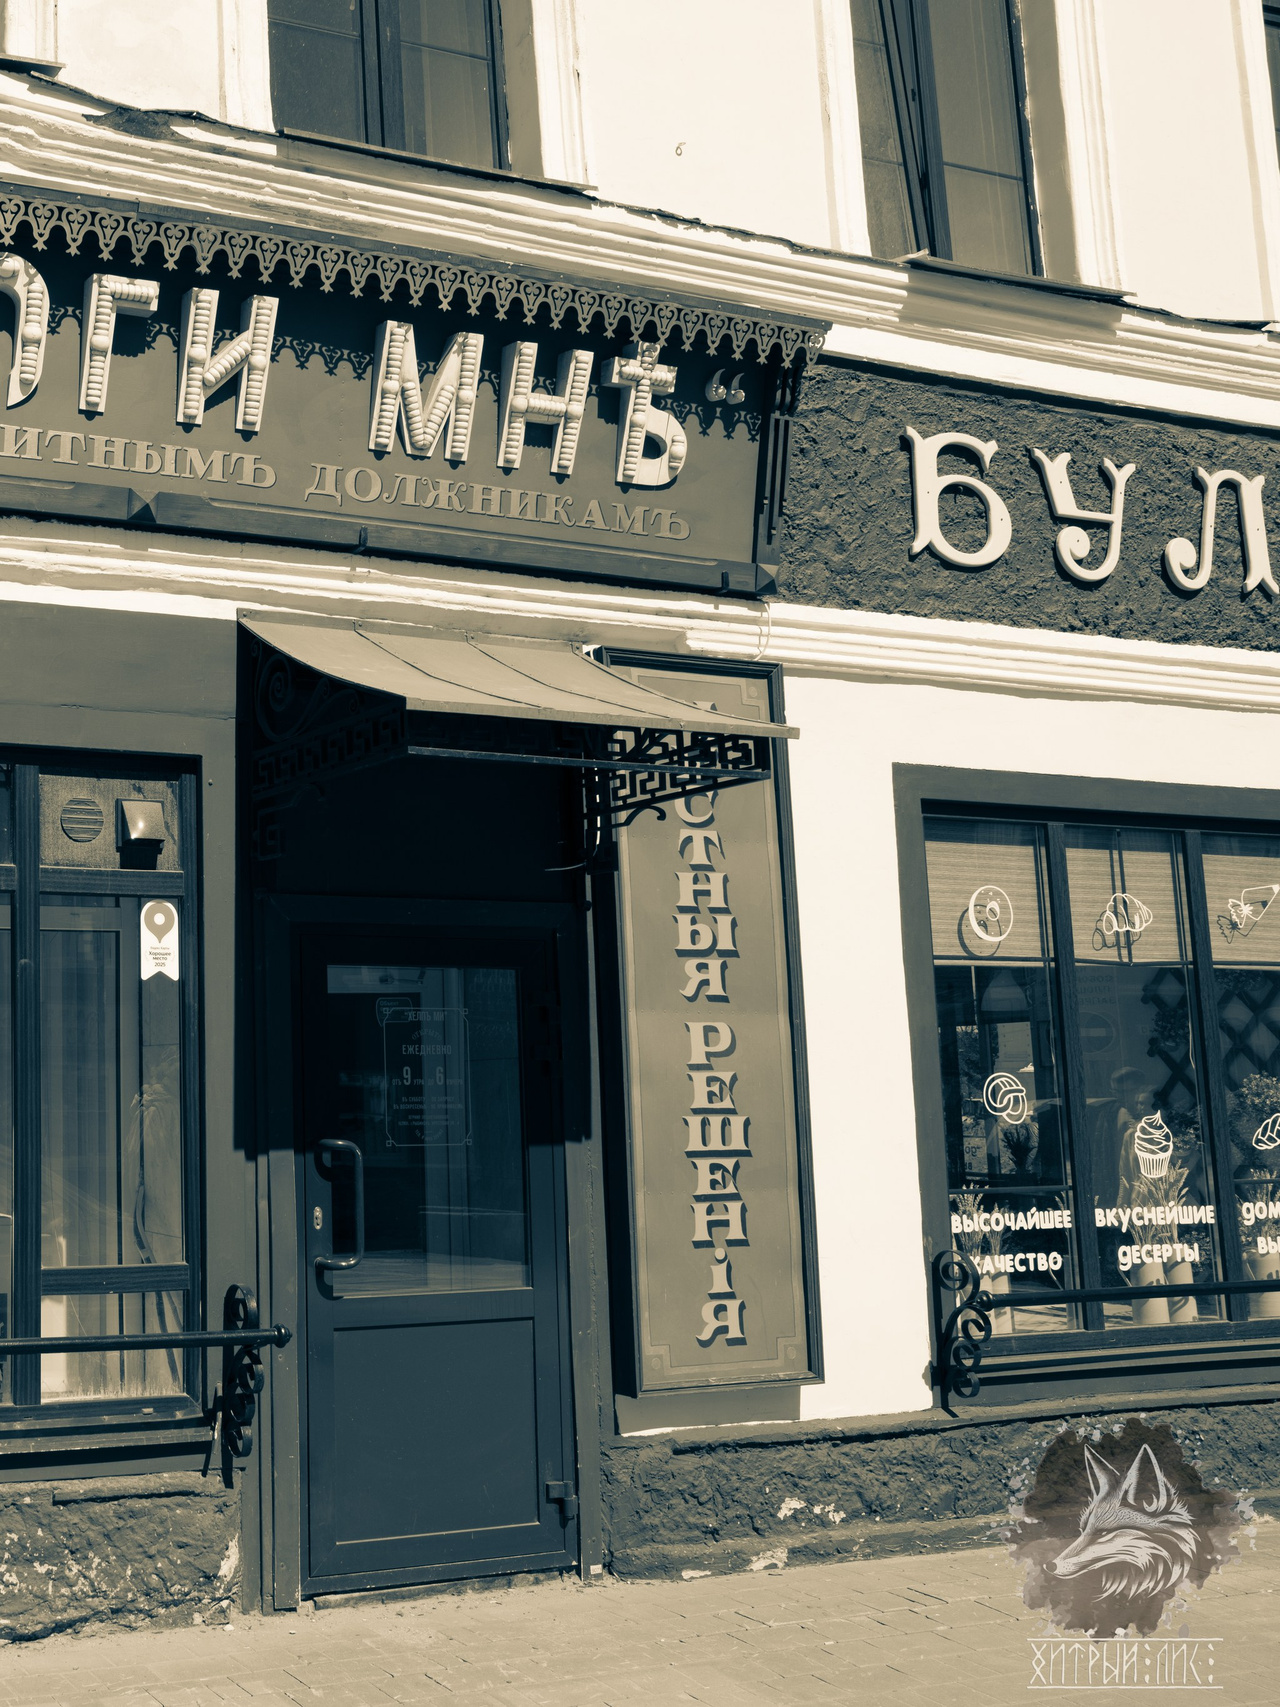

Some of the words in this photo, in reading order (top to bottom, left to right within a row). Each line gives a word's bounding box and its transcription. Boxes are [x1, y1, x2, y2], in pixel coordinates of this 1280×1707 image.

[304, 462, 693, 541] ДОЛЖНИКАМЪ
[951, 1206, 1073, 1234] ВЫСОЧАЙШЕЕ
[1094, 1200, 1216, 1233] ВКУСНЕЙШИЕ
